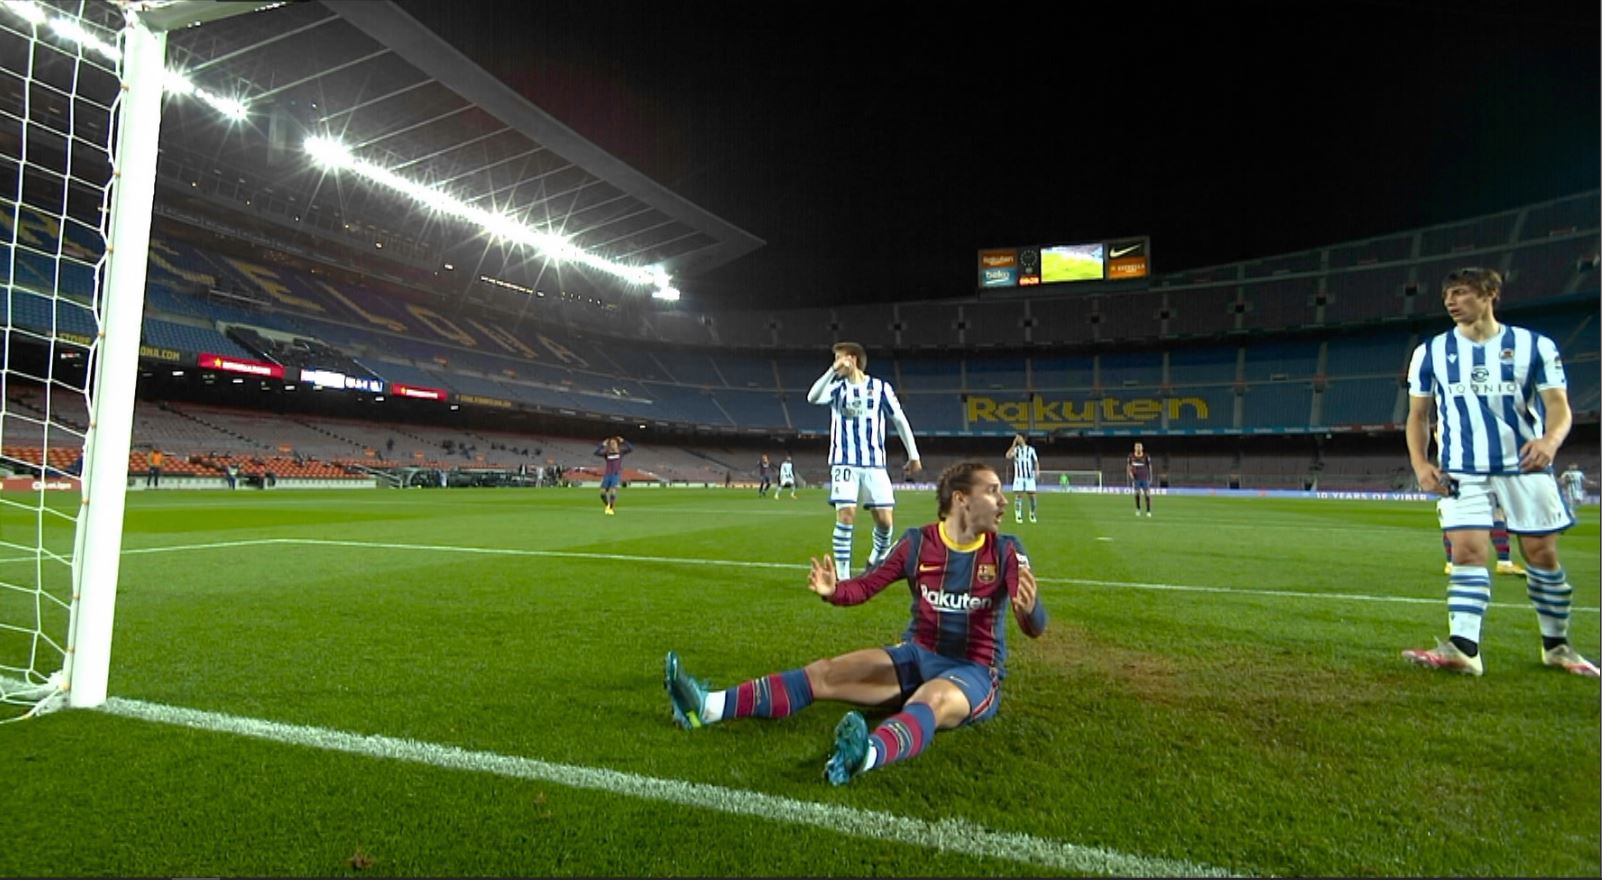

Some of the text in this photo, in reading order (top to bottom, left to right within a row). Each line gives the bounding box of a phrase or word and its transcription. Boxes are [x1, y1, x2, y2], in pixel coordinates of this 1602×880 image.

[967, 396, 1209, 424] Rakuten
[834, 468, 851, 482] 20
[1316, 491, 1328, 499] 10
[1332, 492, 1368, 500] YEARS
[1392, 493, 1427, 501] VIBER
[920, 584, 992, 611] Rakuten
